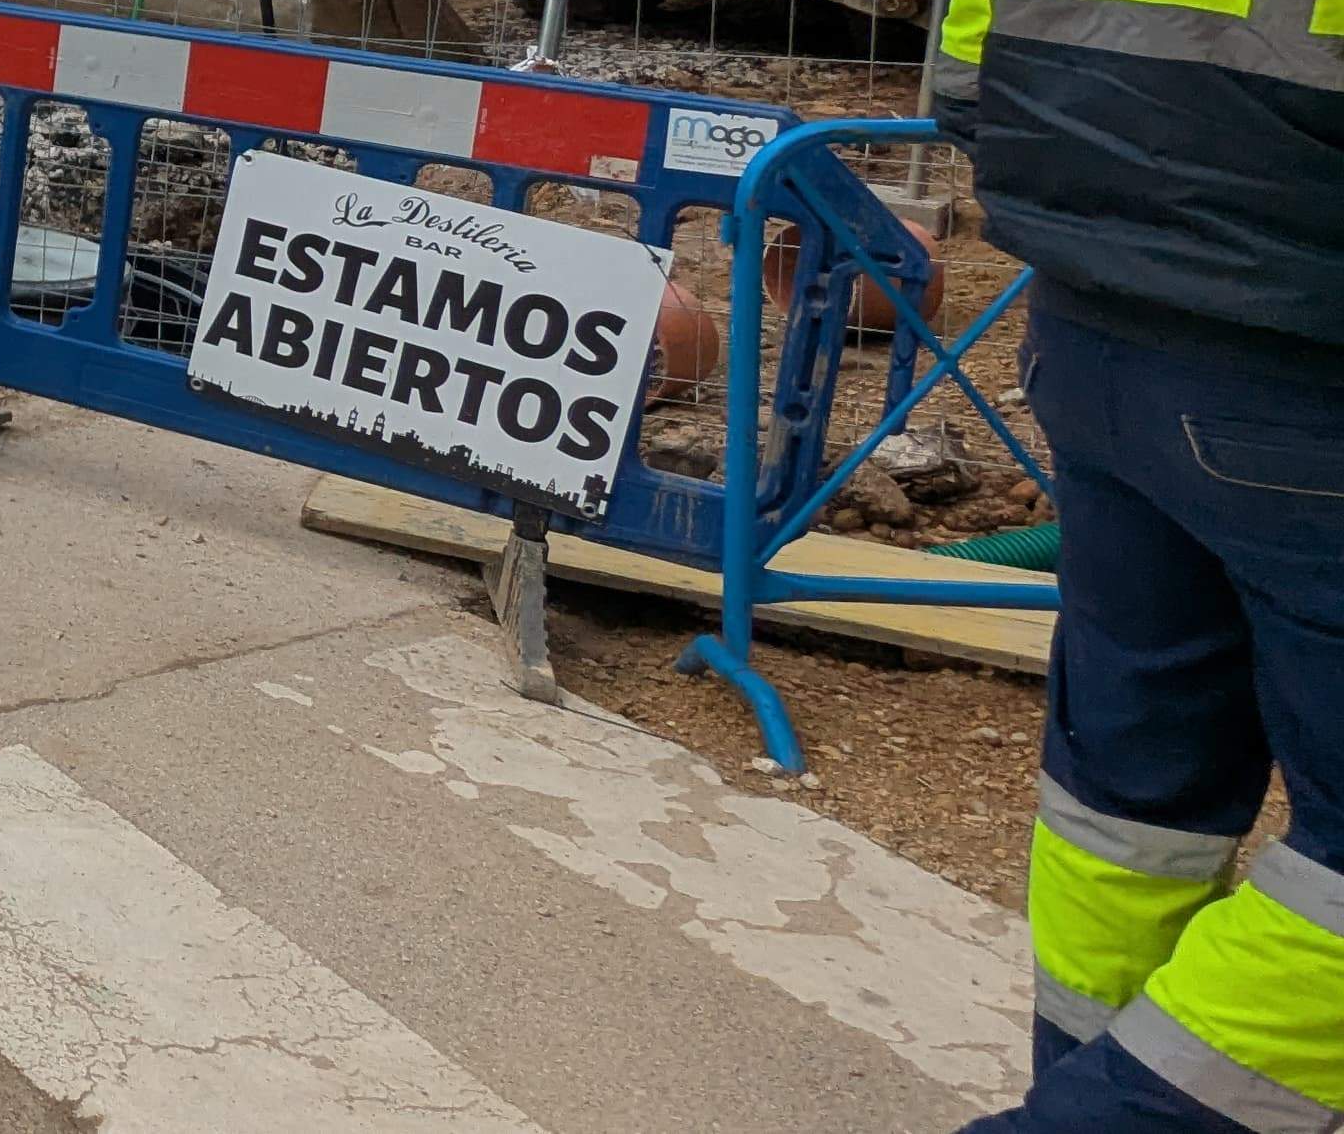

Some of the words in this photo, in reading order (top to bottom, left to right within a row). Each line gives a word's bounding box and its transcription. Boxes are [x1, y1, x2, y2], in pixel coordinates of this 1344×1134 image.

[332, 192, 392, 228] La
[405, 234, 463, 260] BAR
[234, 217, 628, 377] ESTAMOS
[201, 290, 620, 463] ABIERTOS
